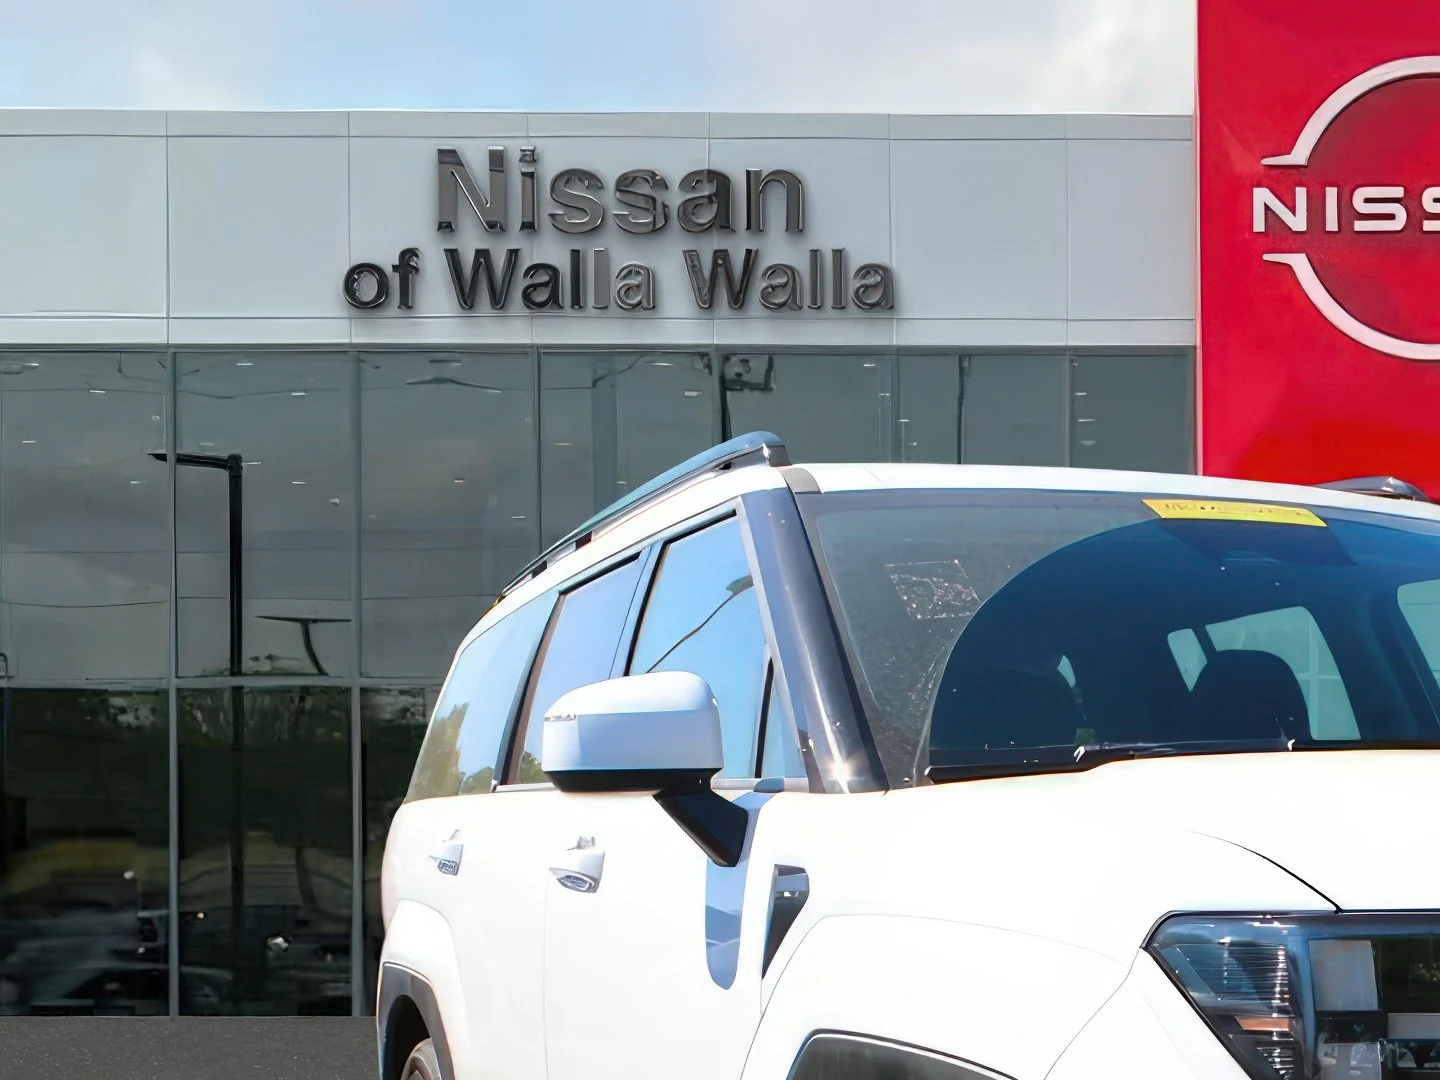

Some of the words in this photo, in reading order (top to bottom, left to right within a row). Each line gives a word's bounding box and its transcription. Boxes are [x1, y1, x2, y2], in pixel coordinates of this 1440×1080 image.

[436, 146, 806, 235] Nissan
[343, 247, 421, 311] of
[443, 247, 657, 311] Walla
[682, 247, 896, 311] Walla
